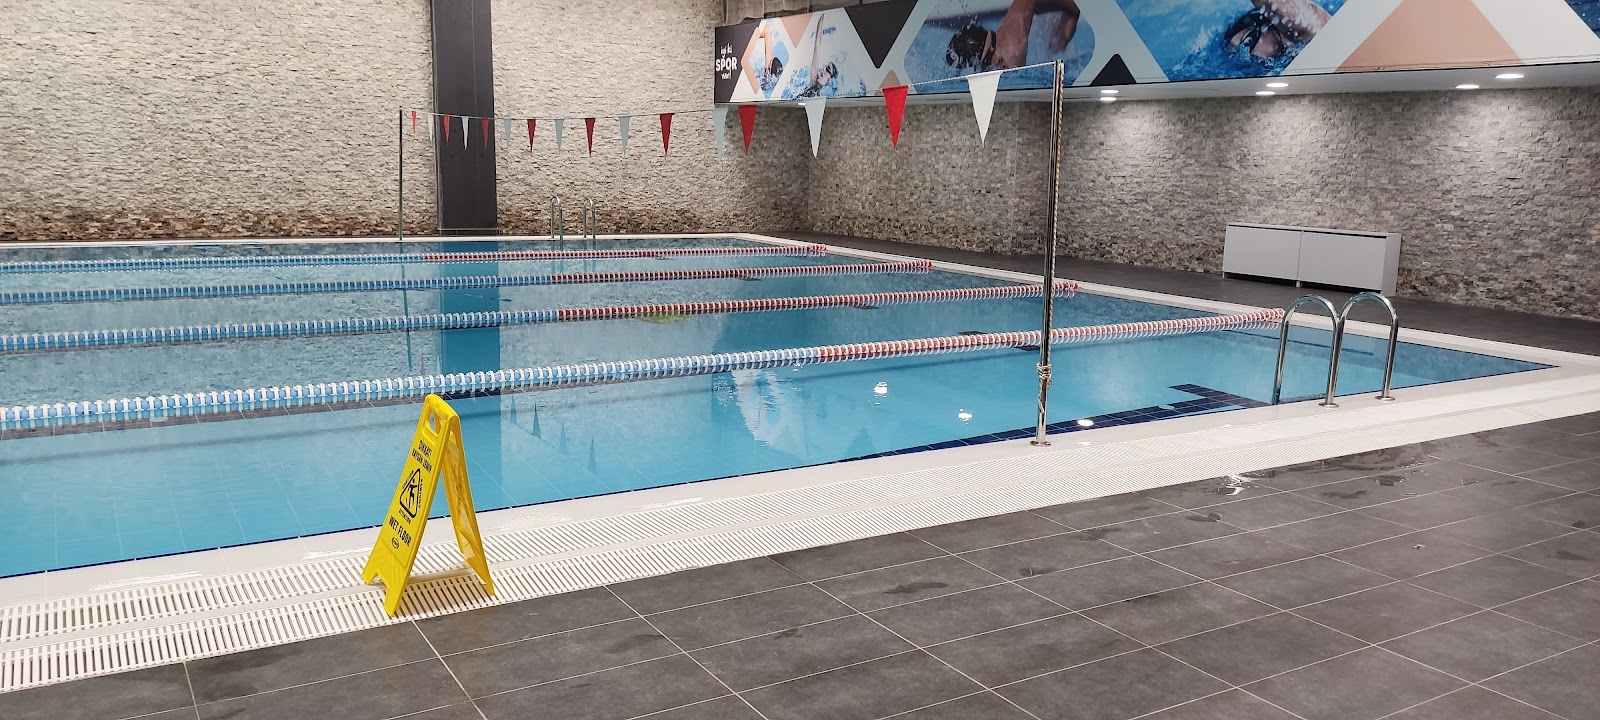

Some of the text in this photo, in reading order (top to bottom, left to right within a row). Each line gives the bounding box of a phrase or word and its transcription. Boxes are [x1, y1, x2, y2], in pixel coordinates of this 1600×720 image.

[715, 57, 738, 72] SPOR
[388, 515, 399, 532] WET
[397, 525, 412, 548] FLOOR
